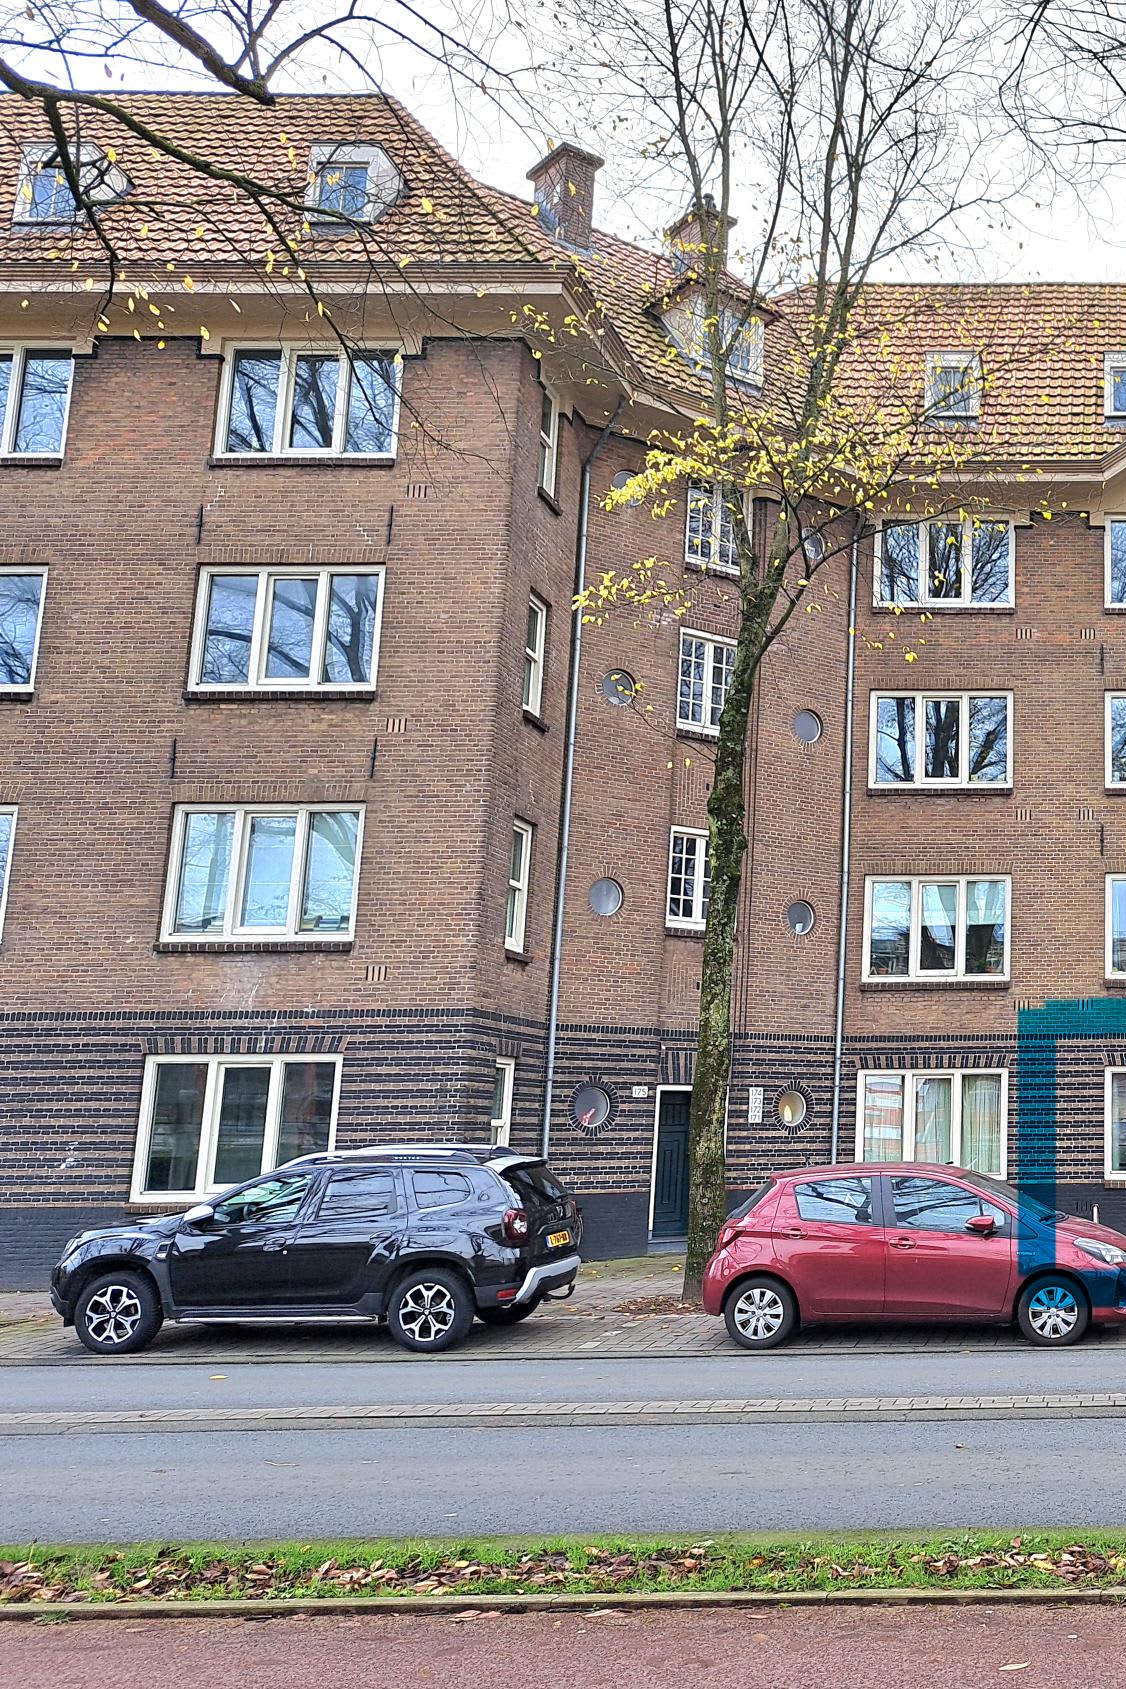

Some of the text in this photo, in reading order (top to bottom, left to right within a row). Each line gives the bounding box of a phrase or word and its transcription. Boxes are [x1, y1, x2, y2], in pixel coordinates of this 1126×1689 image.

[634, 1088, 647, 1097] 175
[751, 1089, 762, 1097] 174
[751, 1097, 762, 1105] 173
[750, 1105, 762, 1113] 172
[750, 1114, 761, 1122] 171
